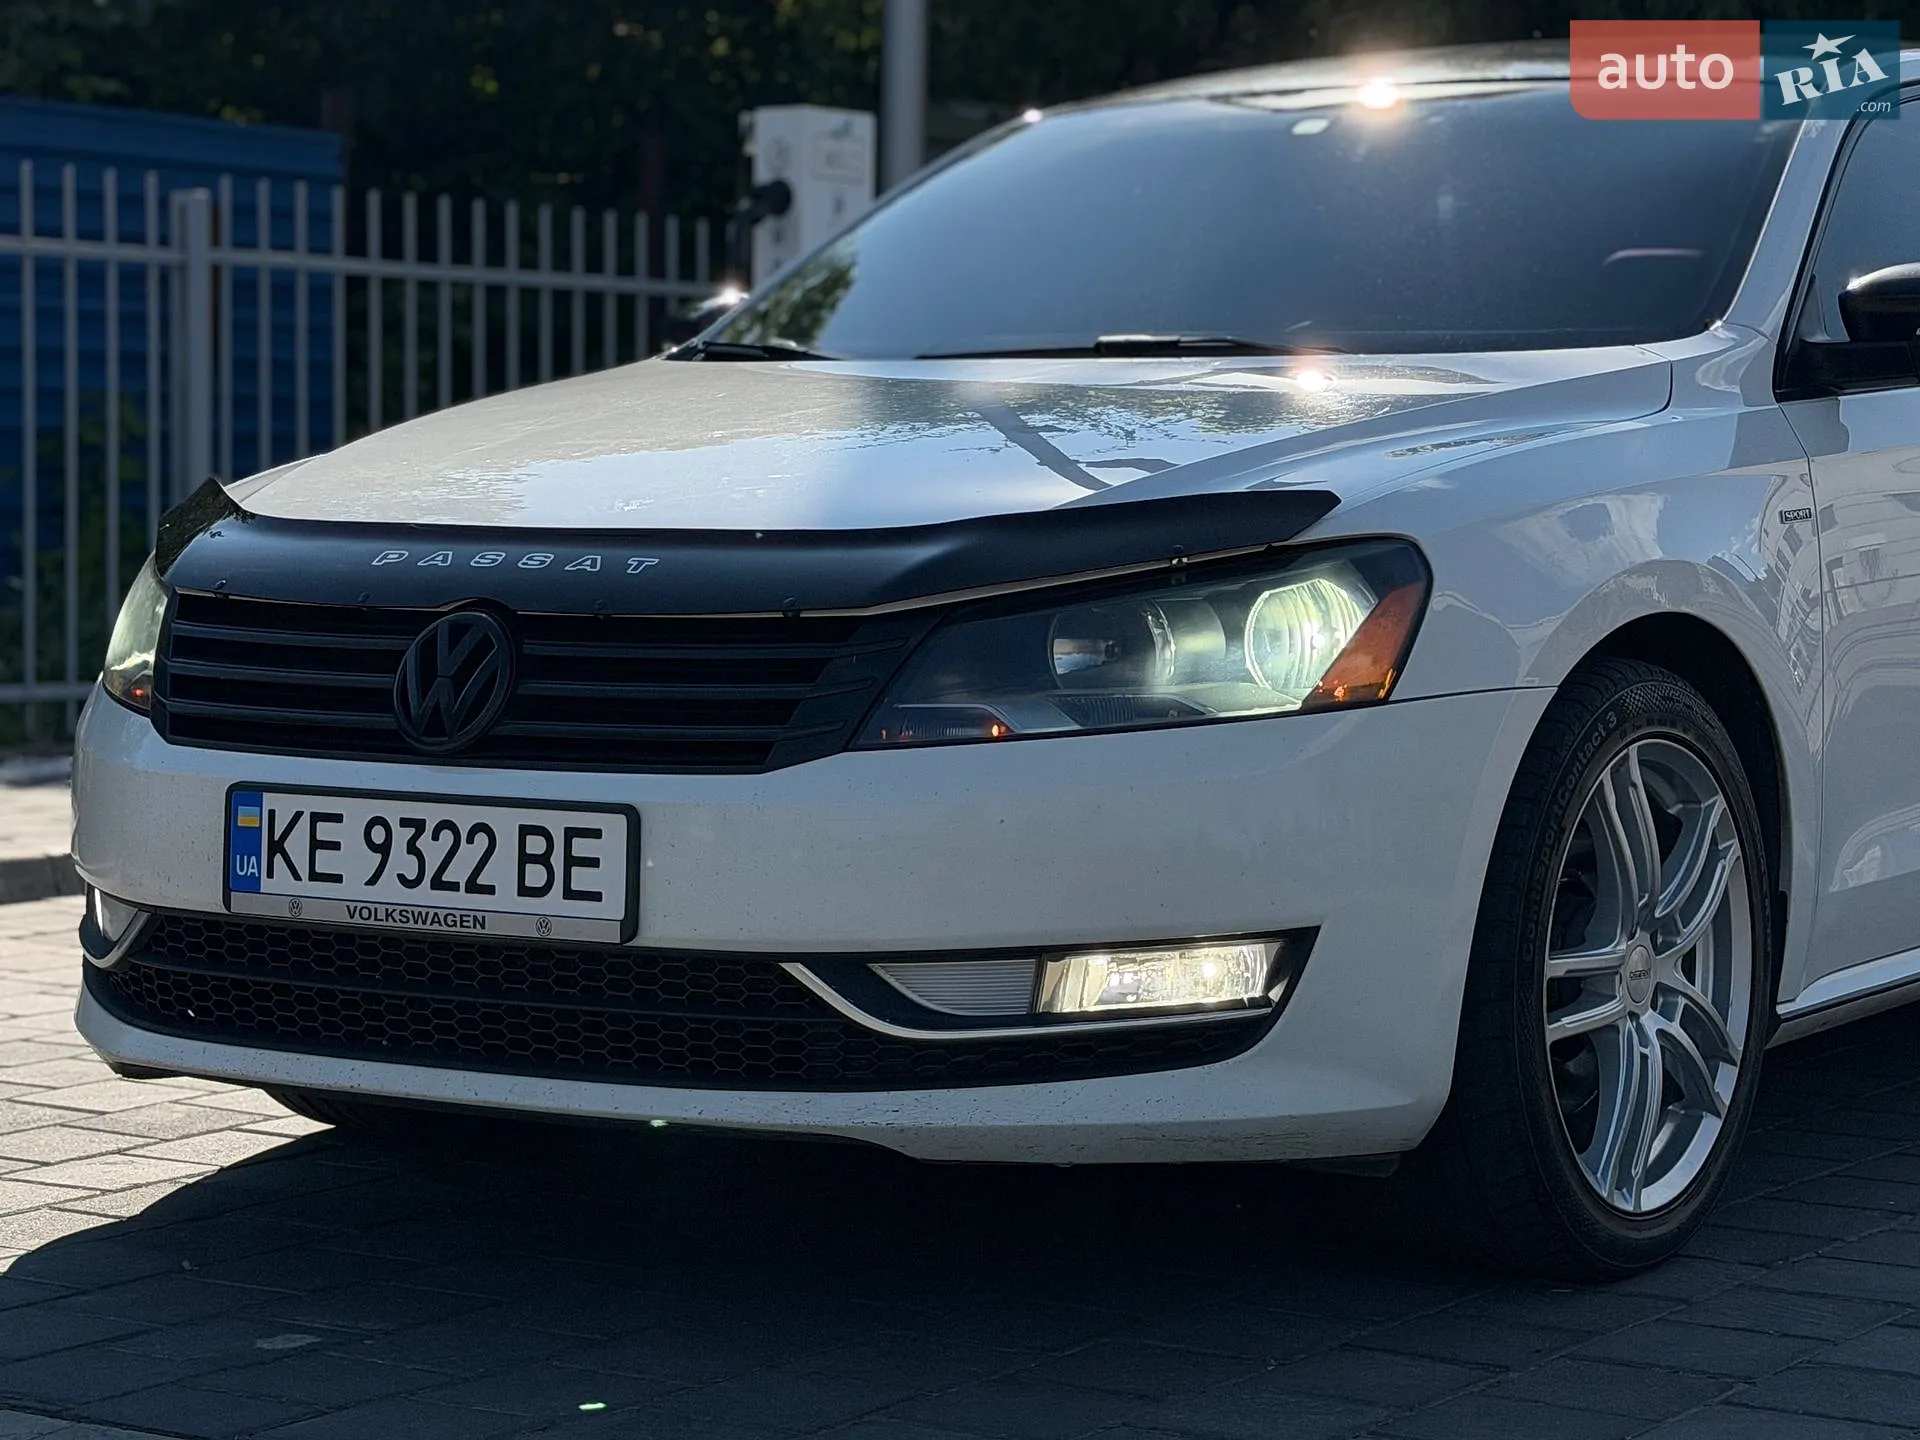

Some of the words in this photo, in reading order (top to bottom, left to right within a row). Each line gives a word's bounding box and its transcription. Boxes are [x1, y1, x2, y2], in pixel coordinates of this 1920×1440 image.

[1785, 509, 1810, 520] SPORT
[371, 550, 660, 574] PASSAT
[1605, 710, 1618, 729] 3
[235, 854, 259, 878] UA
[266, 808, 345, 885] KE
[363, 815, 498, 896] 9322
[516, 823, 604, 903] BE
[346, 904, 487, 930] VOLKSWAGEN
